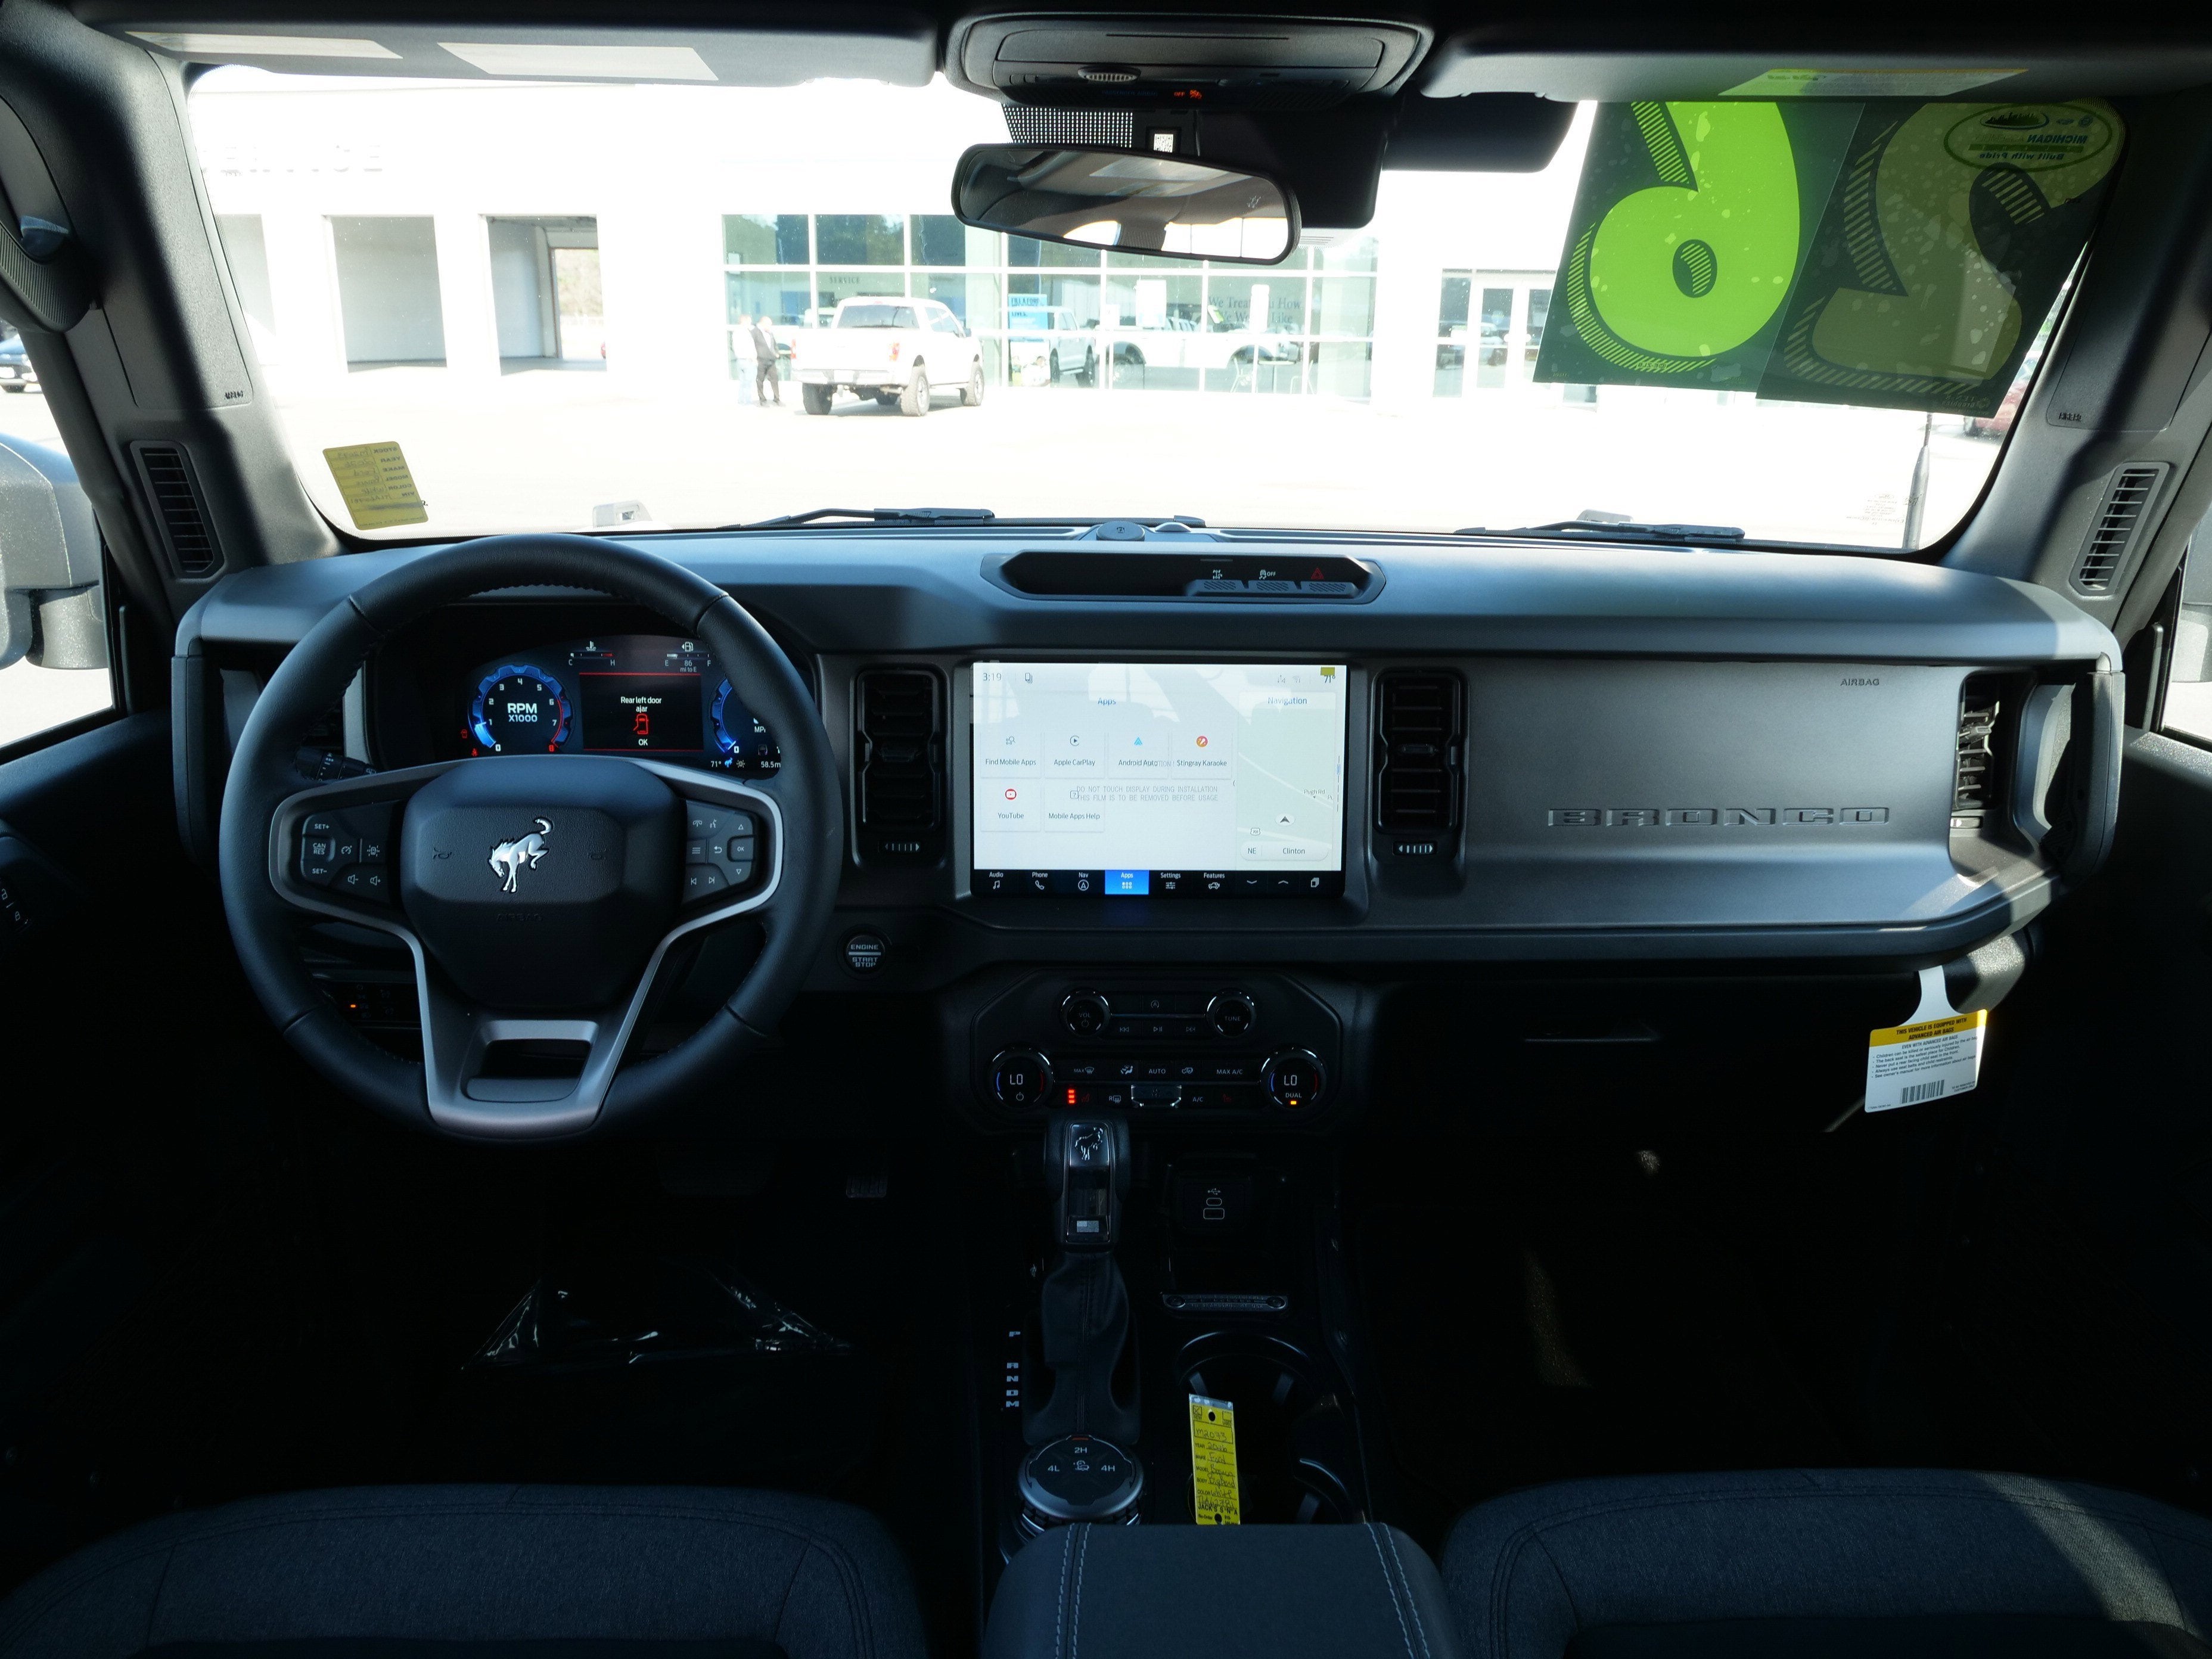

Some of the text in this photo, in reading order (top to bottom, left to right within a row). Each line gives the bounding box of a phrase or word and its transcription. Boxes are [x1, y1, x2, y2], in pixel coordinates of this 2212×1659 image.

[1208, 296, 1301, 309] We How
[1272, 312, 1293, 323] Like
[983, 673, 1002, 681] 3:19
[1841, 678, 1879, 686] AIRBAG
[1098, 698, 1116, 706] Apps
[1267, 697, 1307, 706] Navigation
[508, 703, 538, 714] RPM
[734, 745, 739, 754] 0
[1021, 759, 1036, 767] Apps
[1054, 759, 1095, 767] Apple CarPlay
[1176, 759, 1201, 768] Stingray
[1548, 807, 1890, 827] BRONCO
[1934, 1021, 1955, 1029] EQUIPPED
[1009, 1074, 1023, 1086] LO
[1284, 1075, 1297, 1086] LO
[1198, 1503, 1217, 1512] JACK'S
